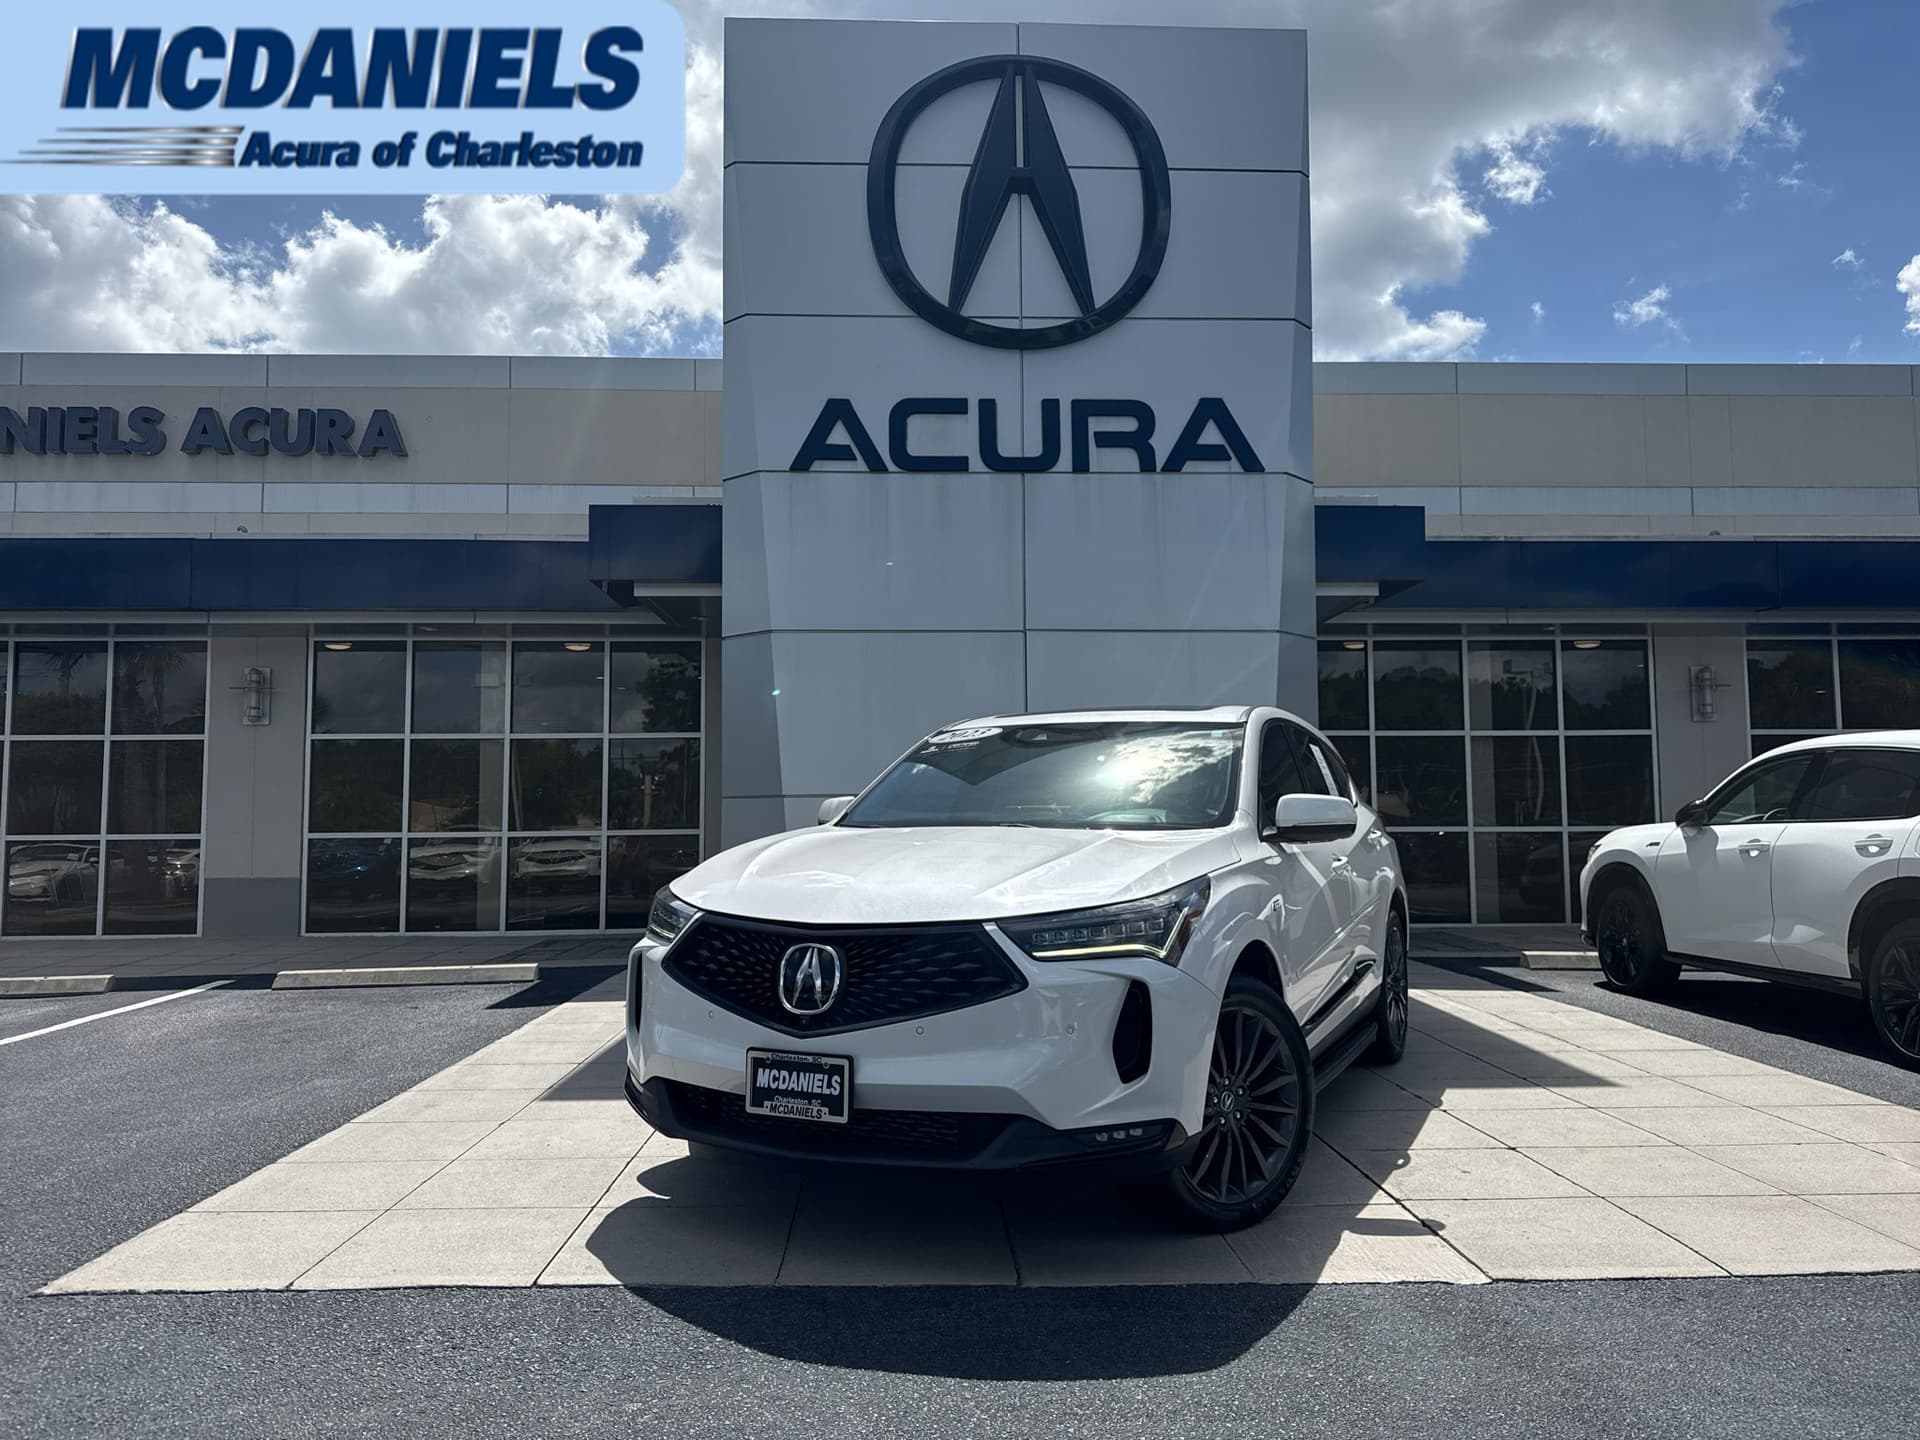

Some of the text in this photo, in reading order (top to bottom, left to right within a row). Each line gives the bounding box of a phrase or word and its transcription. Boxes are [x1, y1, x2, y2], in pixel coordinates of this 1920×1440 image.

[0, 406, 408, 457] NIELS ACURA
[789, 397, 1266, 473] ACURA
[756, 1067, 841, 1095] MCDANIELS
[769, 1103, 823, 1119] MCDANIELS
